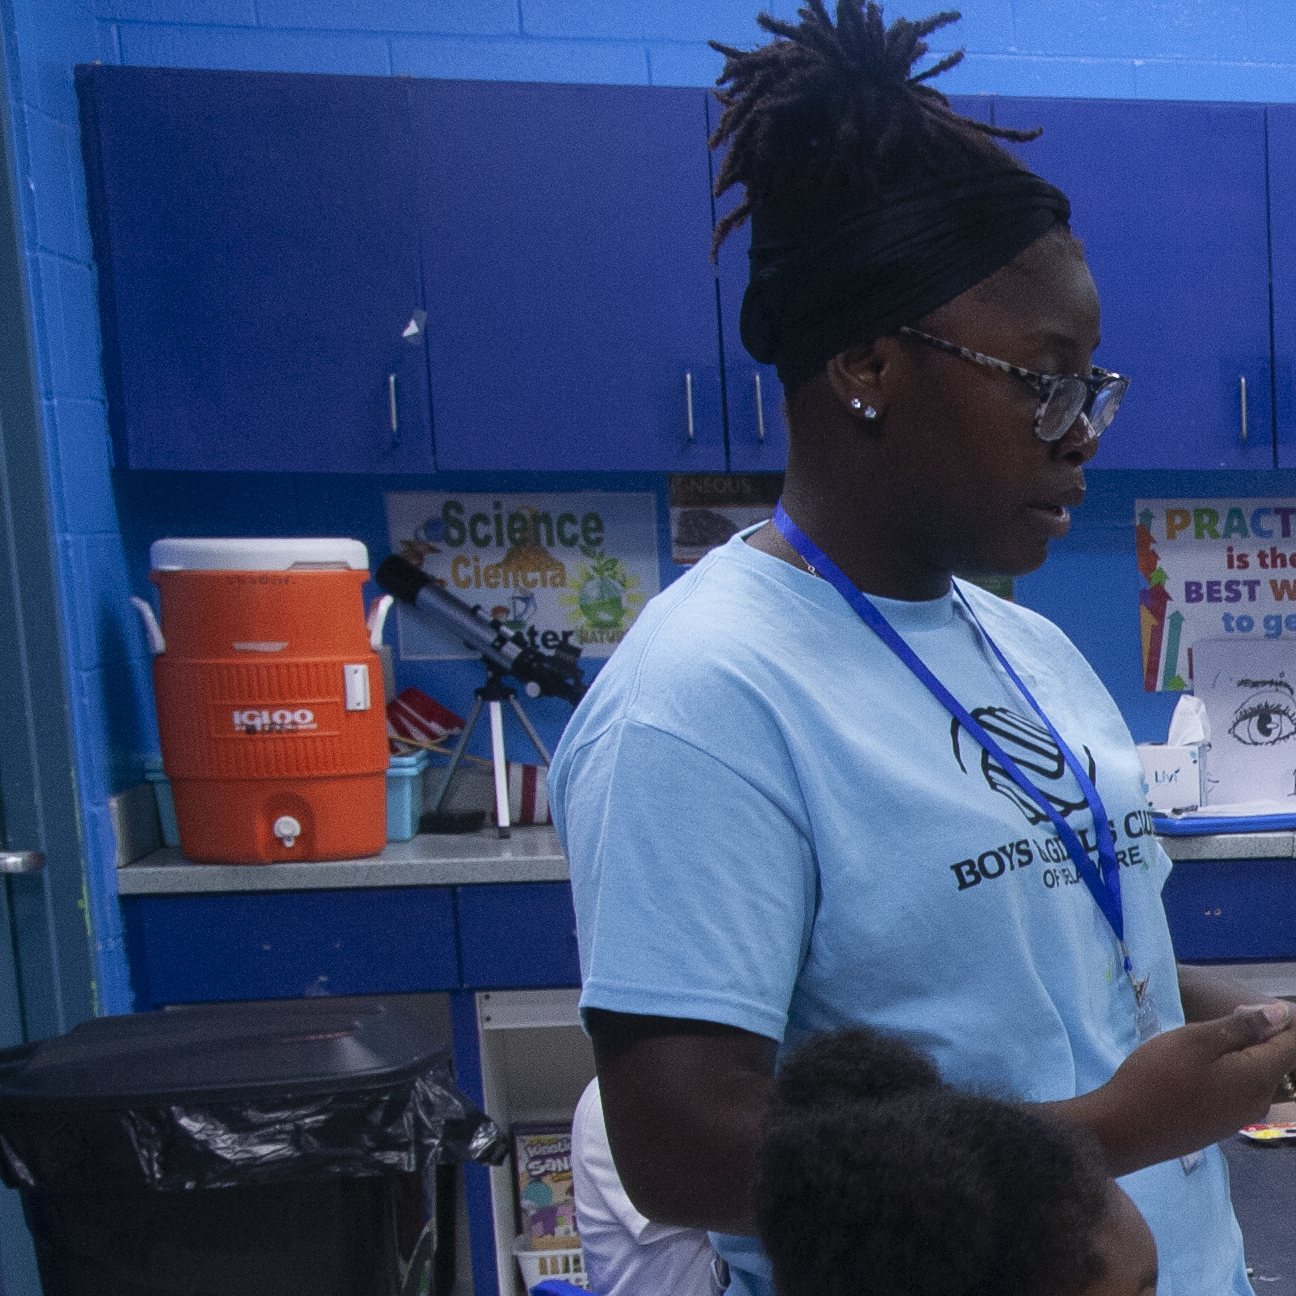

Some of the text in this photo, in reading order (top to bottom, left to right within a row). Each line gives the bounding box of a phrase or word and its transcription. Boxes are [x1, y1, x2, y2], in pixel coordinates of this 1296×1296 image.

[441, 500, 603, 549] Science
[1226, 546, 1250, 570] is
[450, 555, 568, 590] Ciencia
[1184, 579, 1261, 604] BEST
[1221, 611, 1255, 633] to
[232, 708, 315, 726] IGLOO
[950, 838, 1034, 891] BOYS
